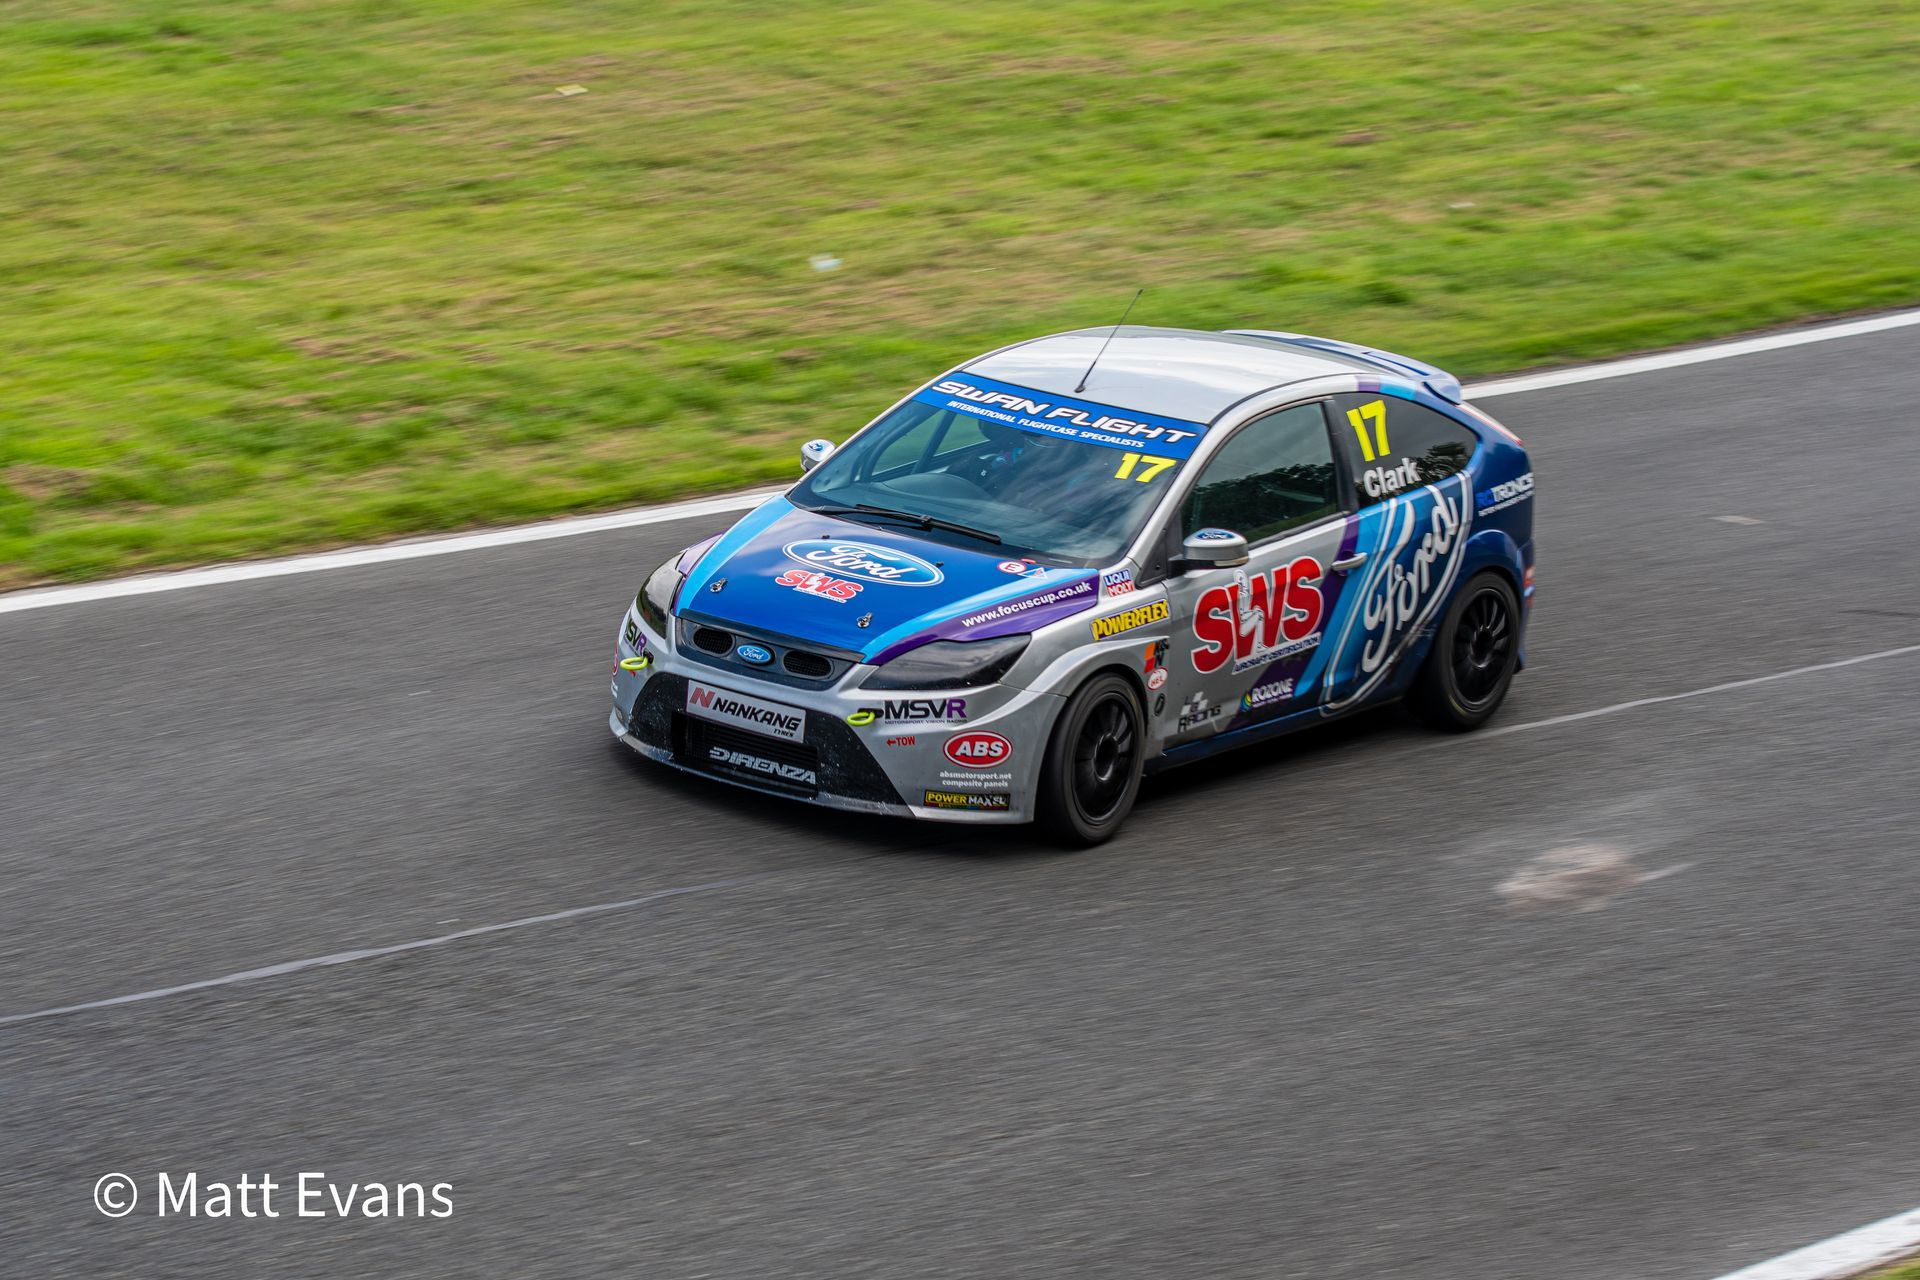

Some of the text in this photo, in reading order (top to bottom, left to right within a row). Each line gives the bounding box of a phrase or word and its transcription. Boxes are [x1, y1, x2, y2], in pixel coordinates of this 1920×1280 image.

[932, 380, 1197, 443] SWAN FLIGHT
[947, 400, 1145, 448] INTERNATIONAL FLIGHTCASE SPECIALISTS
[1346, 400, 1391, 462] 17
[1114, 452, 1177, 483] 17
[1363, 457, 1422, 498] Clark
[805, 544, 917, 579] Ford
[1104, 569, 1130, 586] LIQUI
[775, 569, 864, 600] SWS
[1107, 581, 1134, 597] MOLY
[1362, 484, 1460, 673] Ford
[961, 581, 1092, 628] www.focuscup.co.uk
[1091, 599, 1169, 641] POWERFLEX
[1191, 556, 1324, 674] SWS
[625, 617, 648, 657] SVR
[743, 648, 764, 660] Ford
[1252, 678, 1294, 702] ROZONE
[713, 697, 802, 731] NANKANG
[885, 698, 967, 719] MSVR
[773, 728, 795, 738] TYRES
[896, 736, 916, 747] TOW
[709, 746, 817, 785] DIRENZA
[955, 741, 1005, 758] ABS
[940, 770, 1012, 780] absmotorsport.net
[942, 779, 1008, 788] composite panels
